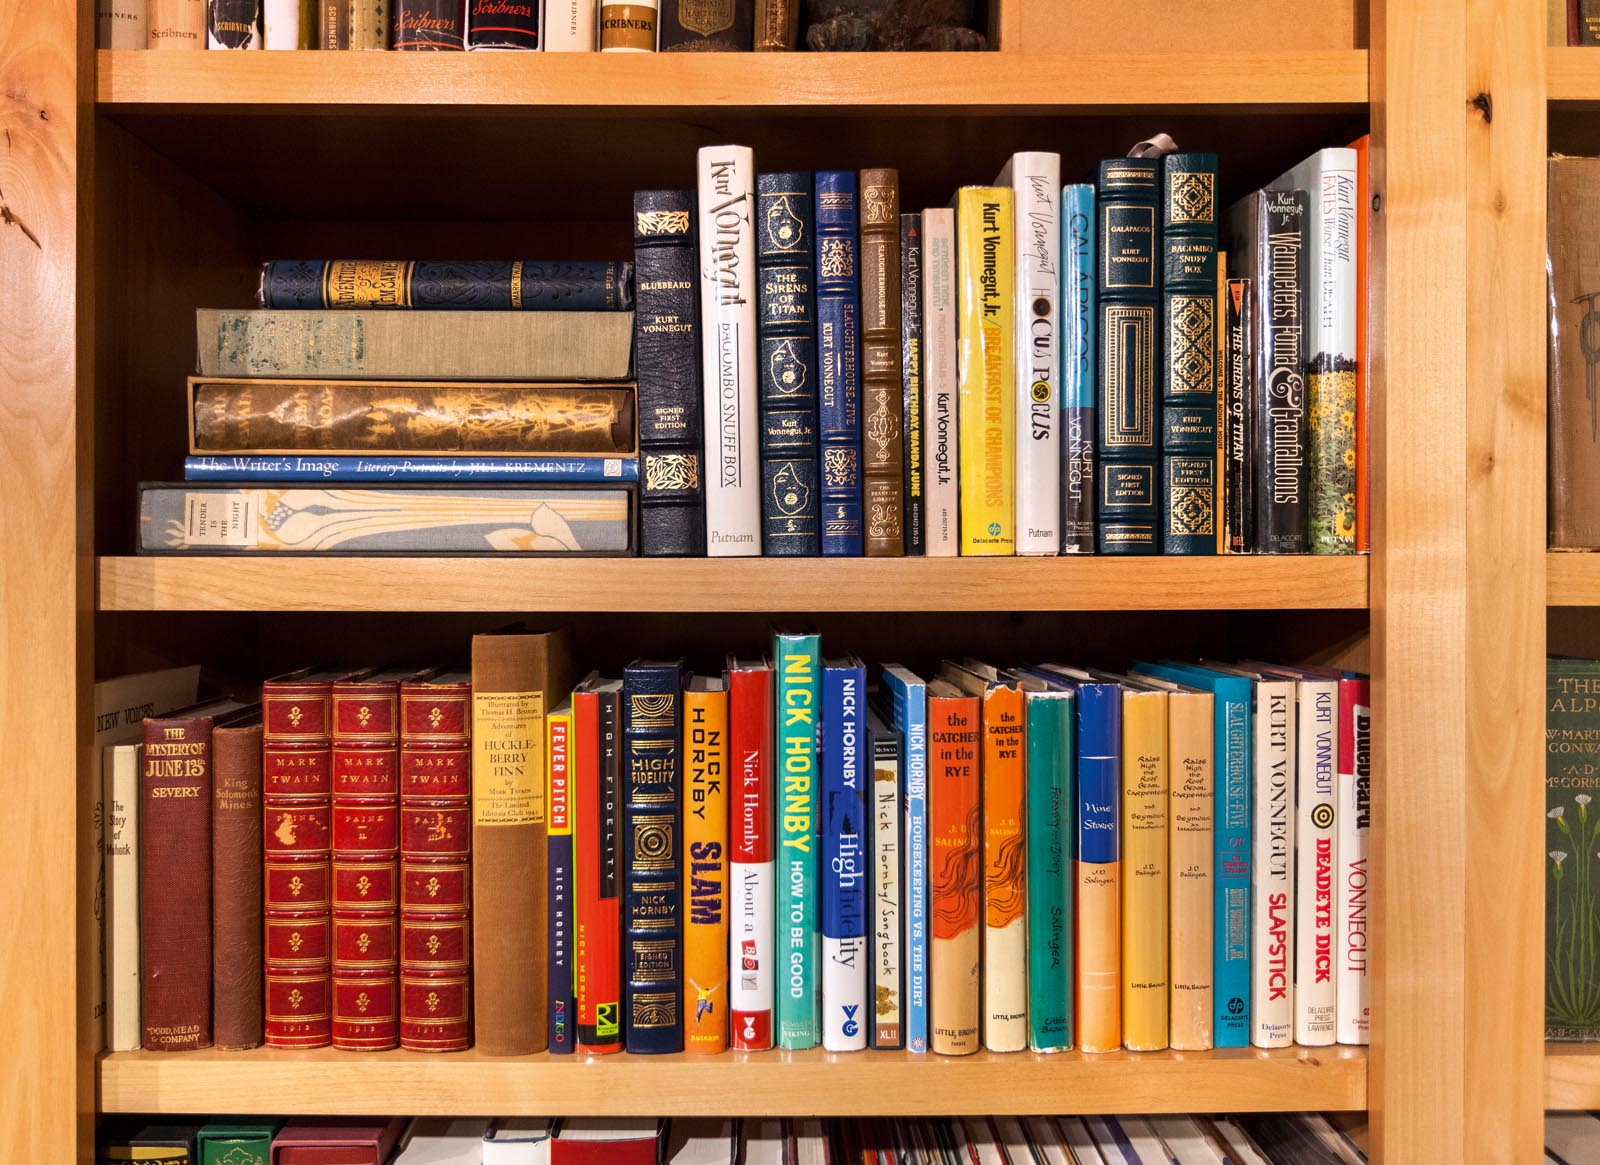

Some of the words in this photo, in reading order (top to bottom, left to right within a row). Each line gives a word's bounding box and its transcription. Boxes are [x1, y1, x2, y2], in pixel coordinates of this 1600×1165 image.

[473, 0, 532, 17] Scribners
[394, 11, 455, 31] Scribners
[152, 29, 198, 39] Scribners
[710, 160, 736, 196] Kurt
[1278, 193, 1295, 205] Kurt
[1337, 176, 1353, 204] Kurt
[983, 203, 1001, 232] Kurt
[1281, 214, 1290, 225] Jr.
[1334, 207, 1353, 262] Vonnegut
[703, 192, 751, 307] Vonnegut
[1171, 245, 1213, 253] BAGOMBO
[1179, 255, 1207, 263] SNUFF
[776, 274, 797, 282] THE
[980, 235, 1001, 302] Vonnegut,
[1184, 265, 1202, 274] BOX
[1269, 231, 1302, 321] Wampeters,
[641, 281, 691, 291] BLUEBEARD
[766, 282, 808, 294] SIRENS
[769, 304, 805, 314] TITAN
[780, 295, 794, 303] OF
[655, 316, 678, 324] KURT
[984, 304, 1001, 317] Jr.
[643, 324, 691, 333] VONNEGUT
[822, 322, 833, 345] KURT
[1270, 325, 1302, 367] Foma
[721, 323, 736, 398] BAGOMBO
[909, 339, 918, 375] HAPPY
[985, 327, 1003, 397] BREAKFAST
[823, 346, 834, 407] VONNEGUT
[1218, 380, 1223, 388] TO
[1232, 354, 1242, 399] SIRENS
[1268, 367, 1303, 408] &
[908, 376, 919, 429] BIRTHDAY,
[937, 393, 950, 413] Kurt
[1233, 402, 1243, 421] OF
[985, 403, 1003, 423] OF
[655, 421, 686, 429] EDITION
[723, 404, 736, 447] SNUFF
[781, 419, 797, 428] Kurt
[1171, 425, 1213, 433] VONNEGUT
[909, 430, 919, 468] WANDA
[936, 415, 950, 474] Vonnegut,
[1233, 423, 1243, 462] TITAN
[1069, 417, 1081, 502] VONNEGUT
[1082, 440, 1093, 482] KURT
[1268, 408, 1303, 504] Granfalloons
[200, 458, 229, 472] The
[232, 458, 292, 472] Writer's
[297, 458, 339, 476] Image
[724, 459, 736, 488] BOX
[985, 426, 1004, 507] CHAMPIONS
[911, 470, 920, 496] JUNE
[938, 475, 950, 485] Jr.
[199, 501, 208, 537] TENDER
[232, 501, 240, 531] NIGHT
[220, 519, 228, 538] THE
[711, 531, 754, 543] Putnam
[1028, 528, 1053, 538] Putnam
[784, 655, 813, 726] NICK
[843, 679, 855, 717] NICK
[488, 700, 519, 708] Illustrated
[520, 700, 529, 708] by
[1316, 692, 1331, 724] KURT
[947, 713, 967, 727] the
[1000, 712, 1015, 722] the
[1270, 694, 1287, 752] KURT
[164, 729, 185, 740] THE
[910, 724, 924, 750] NICK
[996, 738, 1004, 747] in
[1006, 738, 1019, 746] the
[484, 740, 536, 750] HUCKLE-
[552, 726, 565, 772] FEVER
[940, 749, 952, 760] in
[955, 748, 973, 760] the
[999, 750, 1017, 759] RYE
[276, 758, 317, 766] MARK
[344, 758, 384, 766] MARK
[415, 758, 454, 766] MARK
[490, 752, 528, 764] BERRY
[631, 759, 674, 770] HIGH
[692, 708, 705, 819] HORNBY
[708, 731, 721, 795] NICK
[843, 722, 855, 789] HORNBY
[1316, 731, 1332, 796] VONNEGUT
[494, 766, 524, 776] FINN
[631, 771, 674, 784] FIDELITY
[743, 750, 759, 787] Nick
[910, 754, 924, 800] HORNBY
[945, 766, 970, 777] RYE
[225, 779, 248, 789] King
[272, 775, 320, 783] TWAIN
[341, 775, 389, 783] TWAIN
[411, 775, 458, 783] TWAIN
[152, 787, 201, 798] SEVERY
[553, 779, 565, 824] PITCH
[783, 736, 811, 853] HORNBY
[219, 800, 252, 809] Mines
[1085, 802, 1112, 813] Nine
[345, 815, 384, 823] PAINE
[606, 777, 614, 880] FIDELITY
[740, 793, 759, 855] Hornby
[1083, 820, 1114, 831] Stories
[1270, 760, 1287, 881] VONNEGUT
[912, 816, 922, 918] HOUSEKEEPING
[690, 841, 722, 925] SLAM
[791, 860, 803, 898] HOW
[1316, 838, 1331, 928] DEADEYE
[632, 905, 675, 915] HORNBY
[642, 896, 665, 904] NICK
[791, 902, 803, 924] TO
[1348, 858, 1367, 976] VONNEGUT
[790, 928, 803, 948] BE
[912, 922, 922, 940] VS.
[1269, 893, 1287, 1001] SLAPSTICK
[912, 945, 922, 972] THE
[1315, 934, 1331, 984] DICK
[791, 952, 803, 998] GOOD
[912, 975, 922, 1007] DIRT
[555, 1000, 565, 1043] INDIGO
[880, 1030, 897, 1039] XLII
